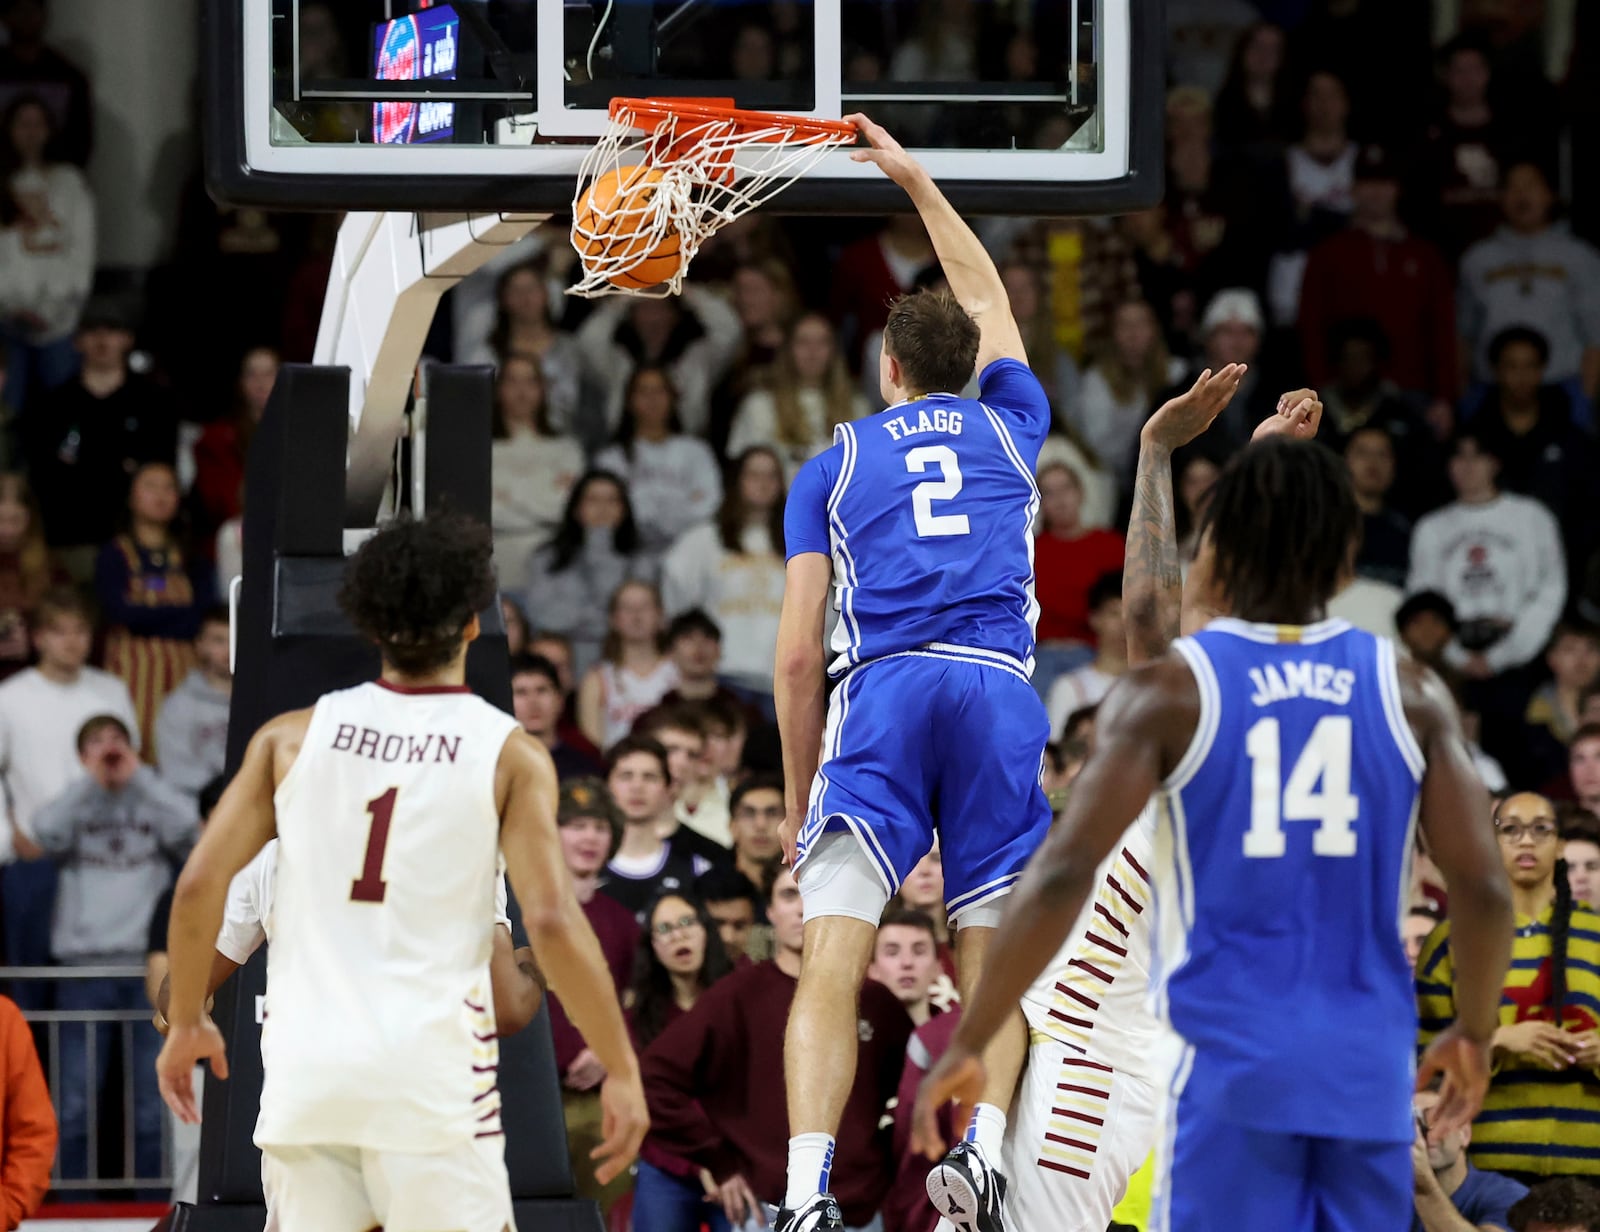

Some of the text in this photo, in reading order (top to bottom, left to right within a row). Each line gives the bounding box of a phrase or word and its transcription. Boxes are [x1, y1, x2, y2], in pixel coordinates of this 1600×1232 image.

[882, 409, 963, 441] FLAGG
[905, 445, 970, 537] 2
[1248, 661, 1356, 707] JAMES
[330, 723, 462, 764] BROWN
[1243, 714, 1359, 859] 14
[349, 786, 398, 905] 1
